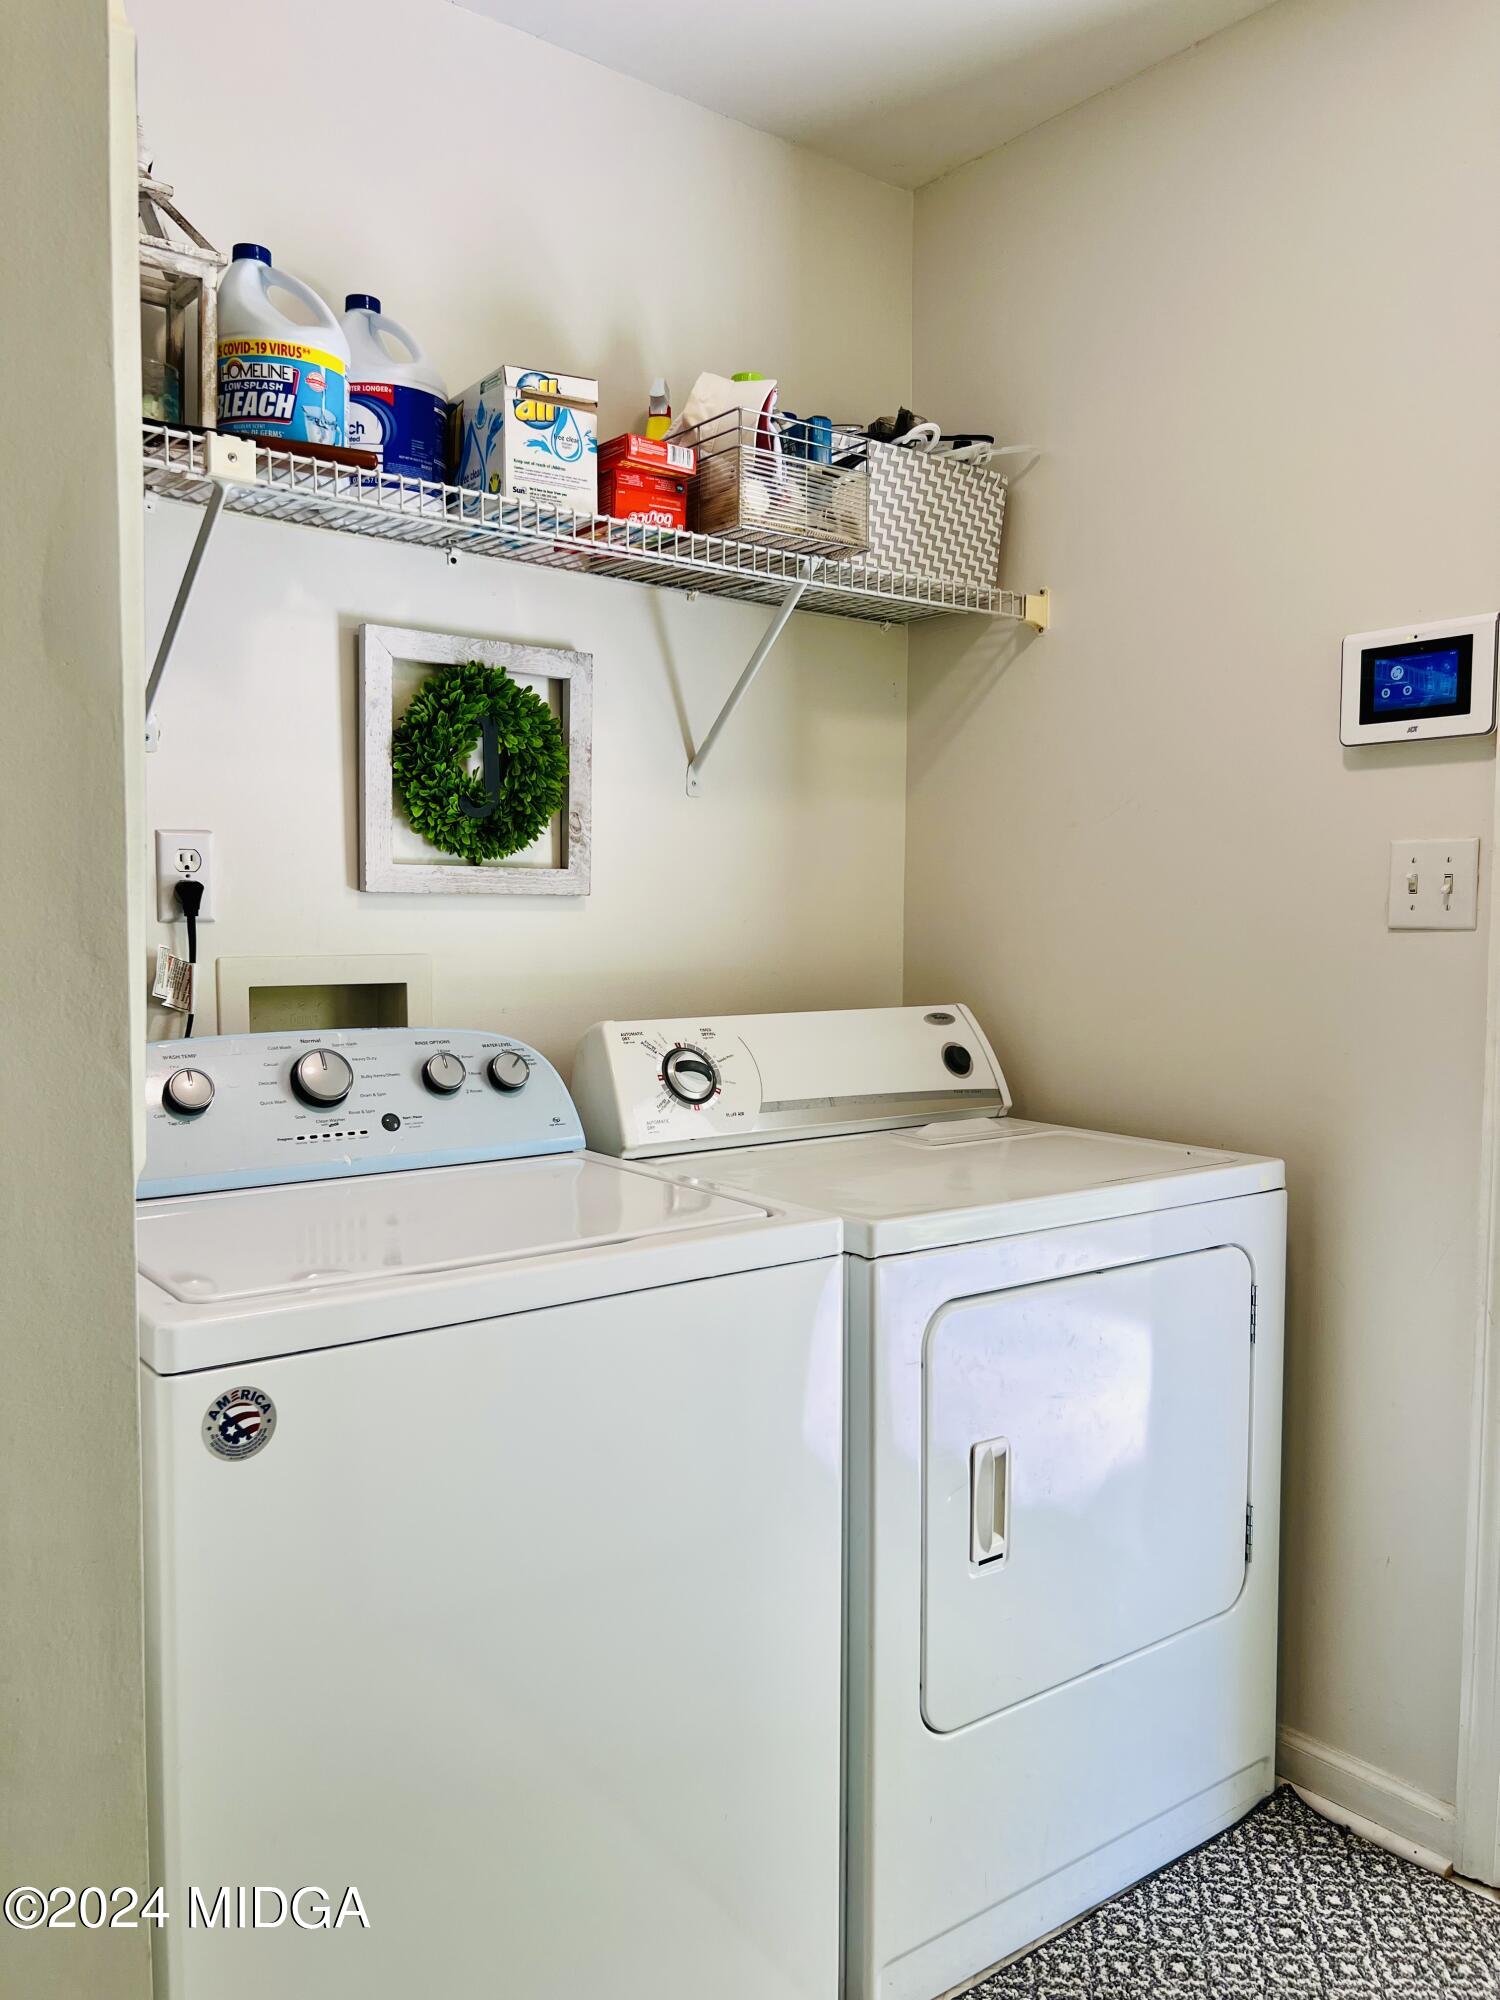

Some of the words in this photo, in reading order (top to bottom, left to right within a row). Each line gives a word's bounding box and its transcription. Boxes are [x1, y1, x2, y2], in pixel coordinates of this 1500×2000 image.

[223, 341, 267, 355] COVID-19
[222, 361, 291, 380] HOMELINE
[224, 381, 284, 391] LOW-SPLASH
[515, 399, 555, 422] all
[512, 486, 526, 494] Sun
[208, 1389, 272, 1421] AMERICA
